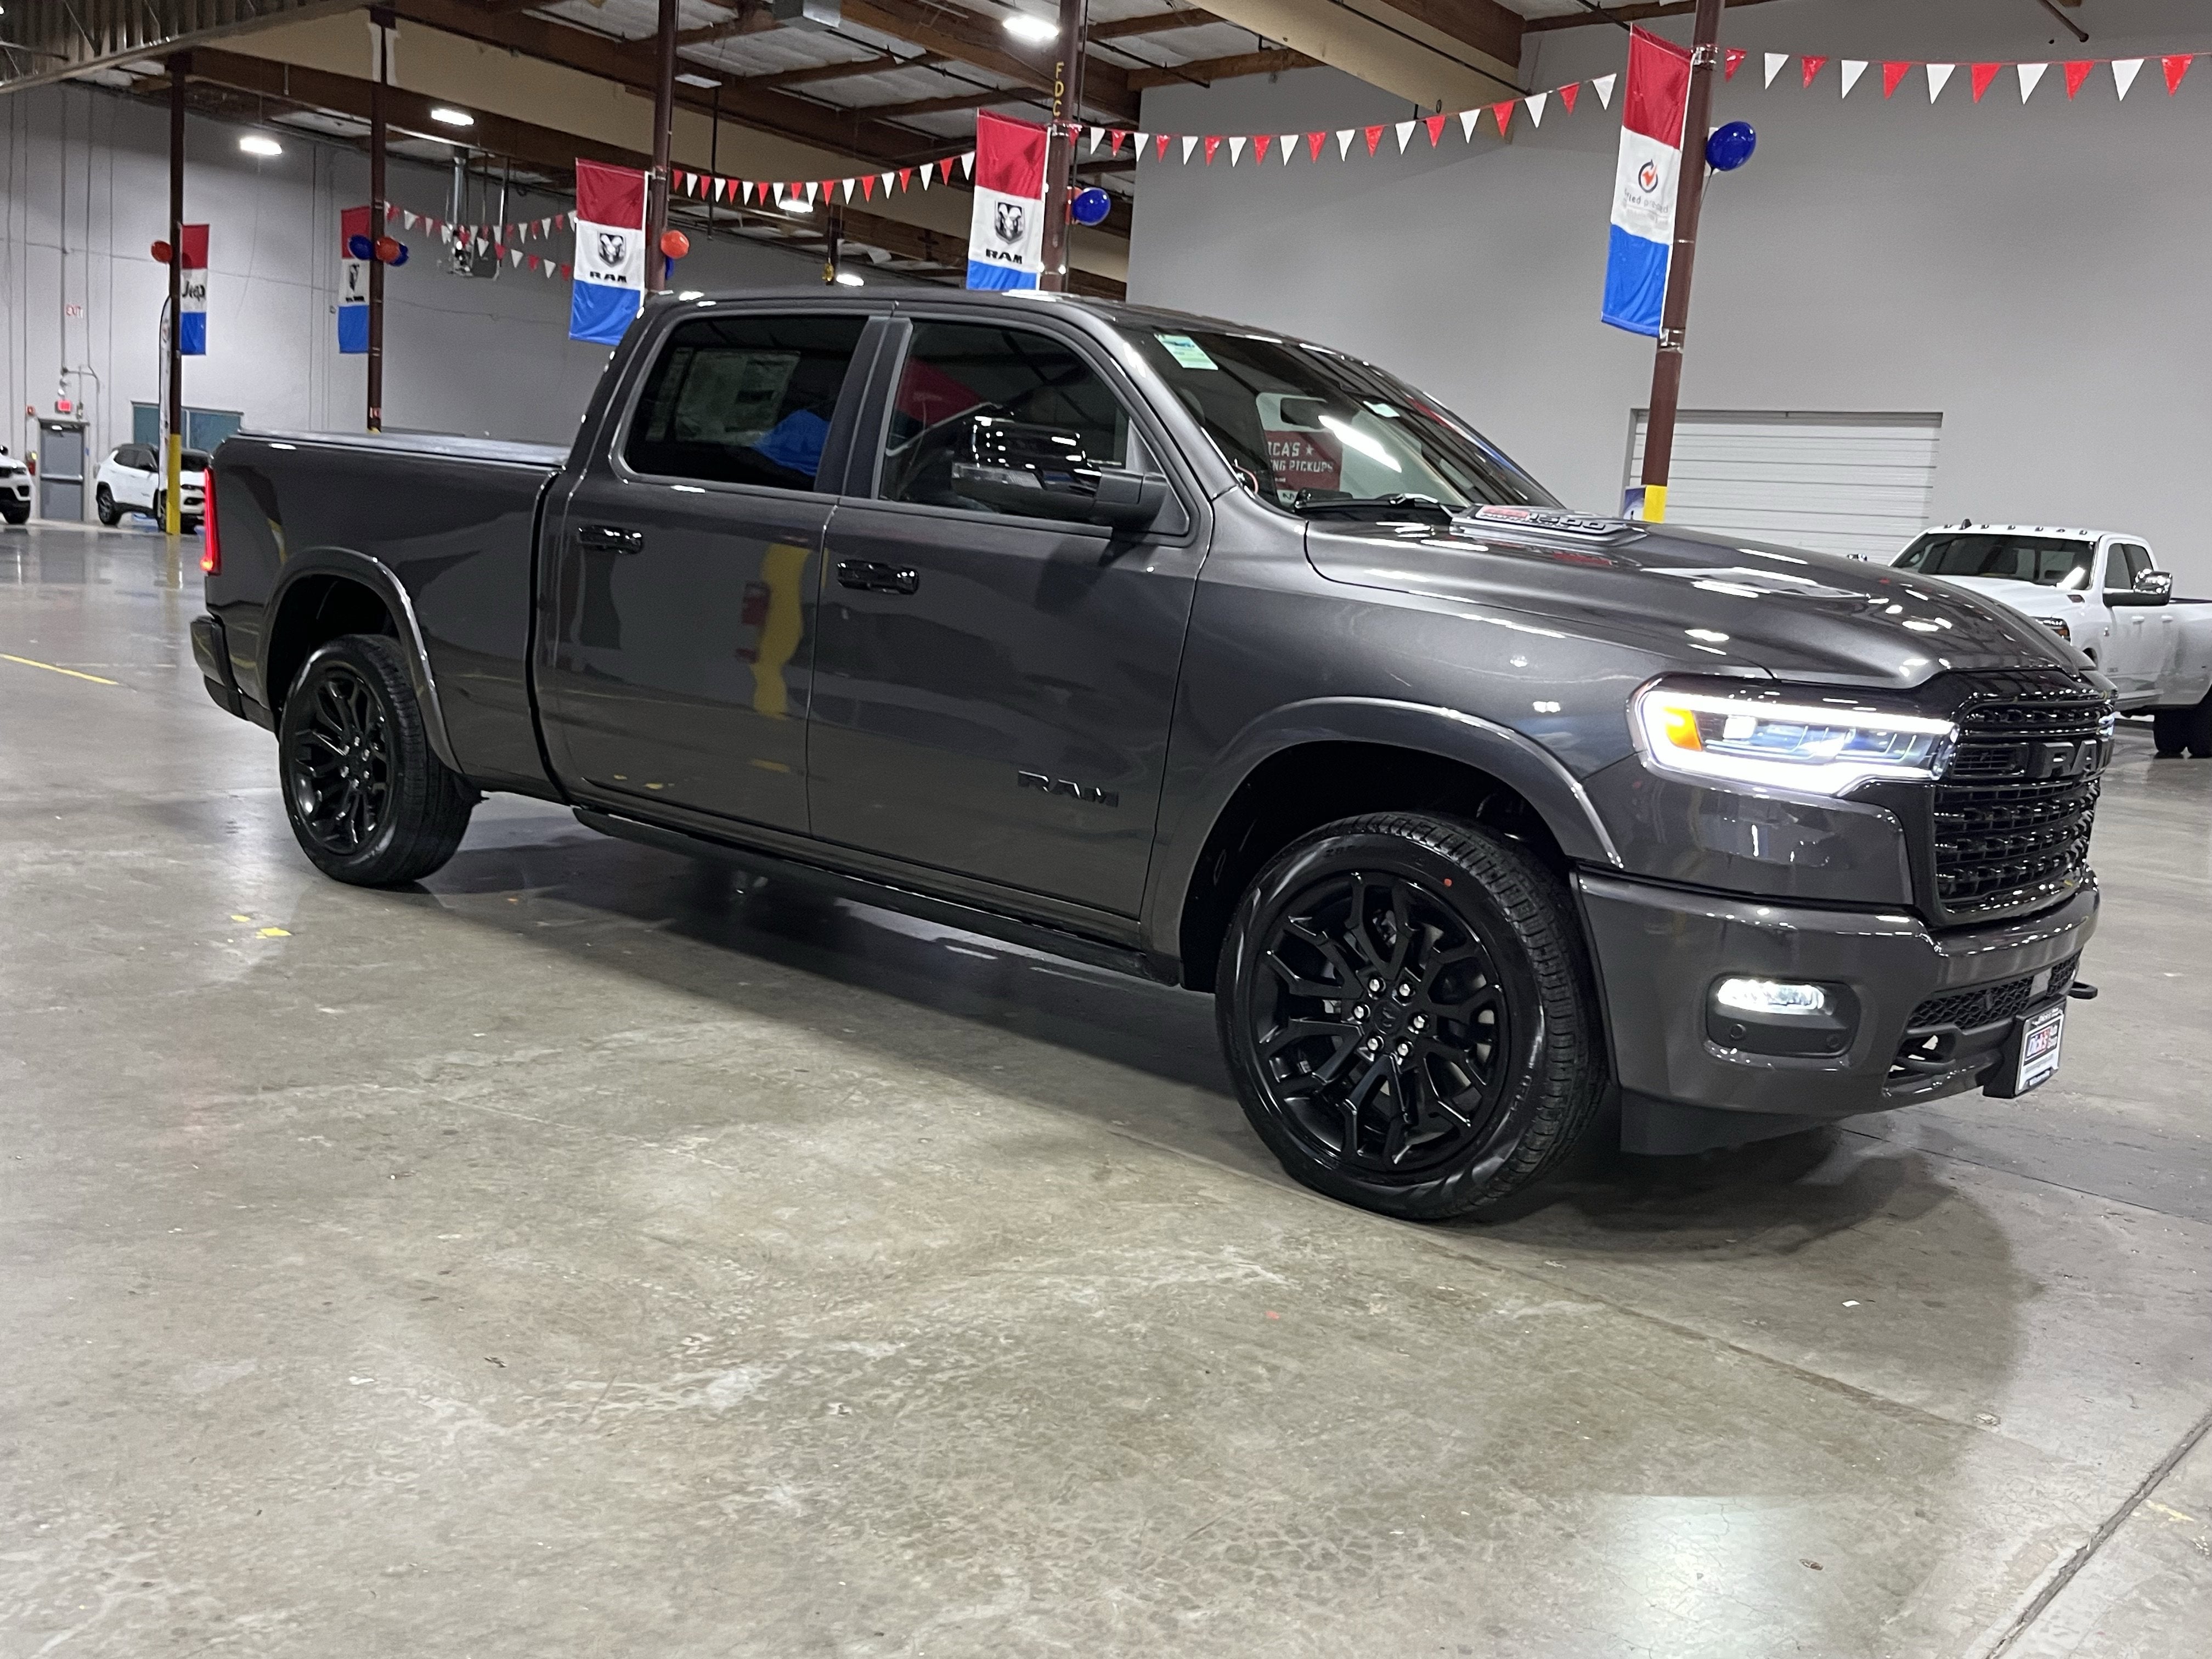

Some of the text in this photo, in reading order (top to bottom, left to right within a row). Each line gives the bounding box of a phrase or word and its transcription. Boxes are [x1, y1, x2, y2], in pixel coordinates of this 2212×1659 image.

[1053, 61, 1064, 116] FDC
[986, 249, 1022, 264] RAM
[590, 271, 627, 283] RAM
[1289, 460, 1333, 473] PICKUPS
[1018, 771, 1119, 808] RAM
